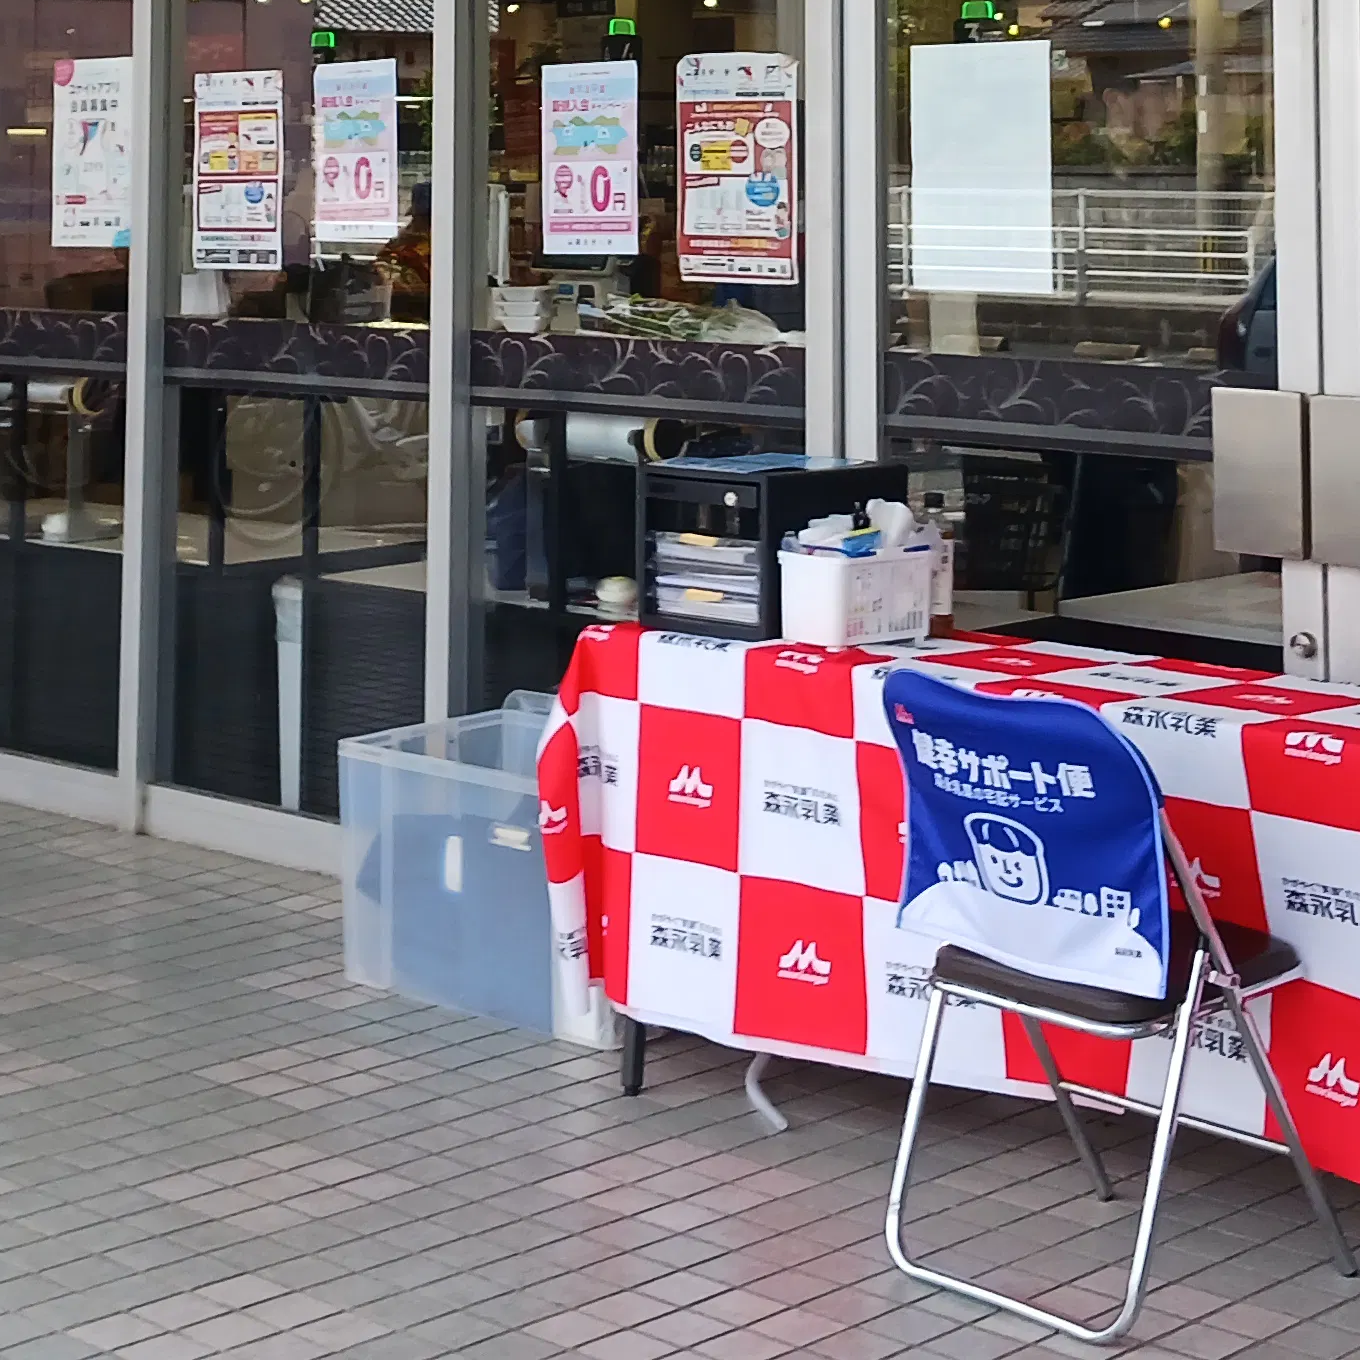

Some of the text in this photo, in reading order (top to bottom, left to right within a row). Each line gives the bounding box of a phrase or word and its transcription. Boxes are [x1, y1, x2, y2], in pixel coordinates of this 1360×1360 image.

[1122, 706, 1223, 739] 森永乳業
[762, 791, 842, 828] 森永乳業
[649, 924, 723, 961] 森永乳業
